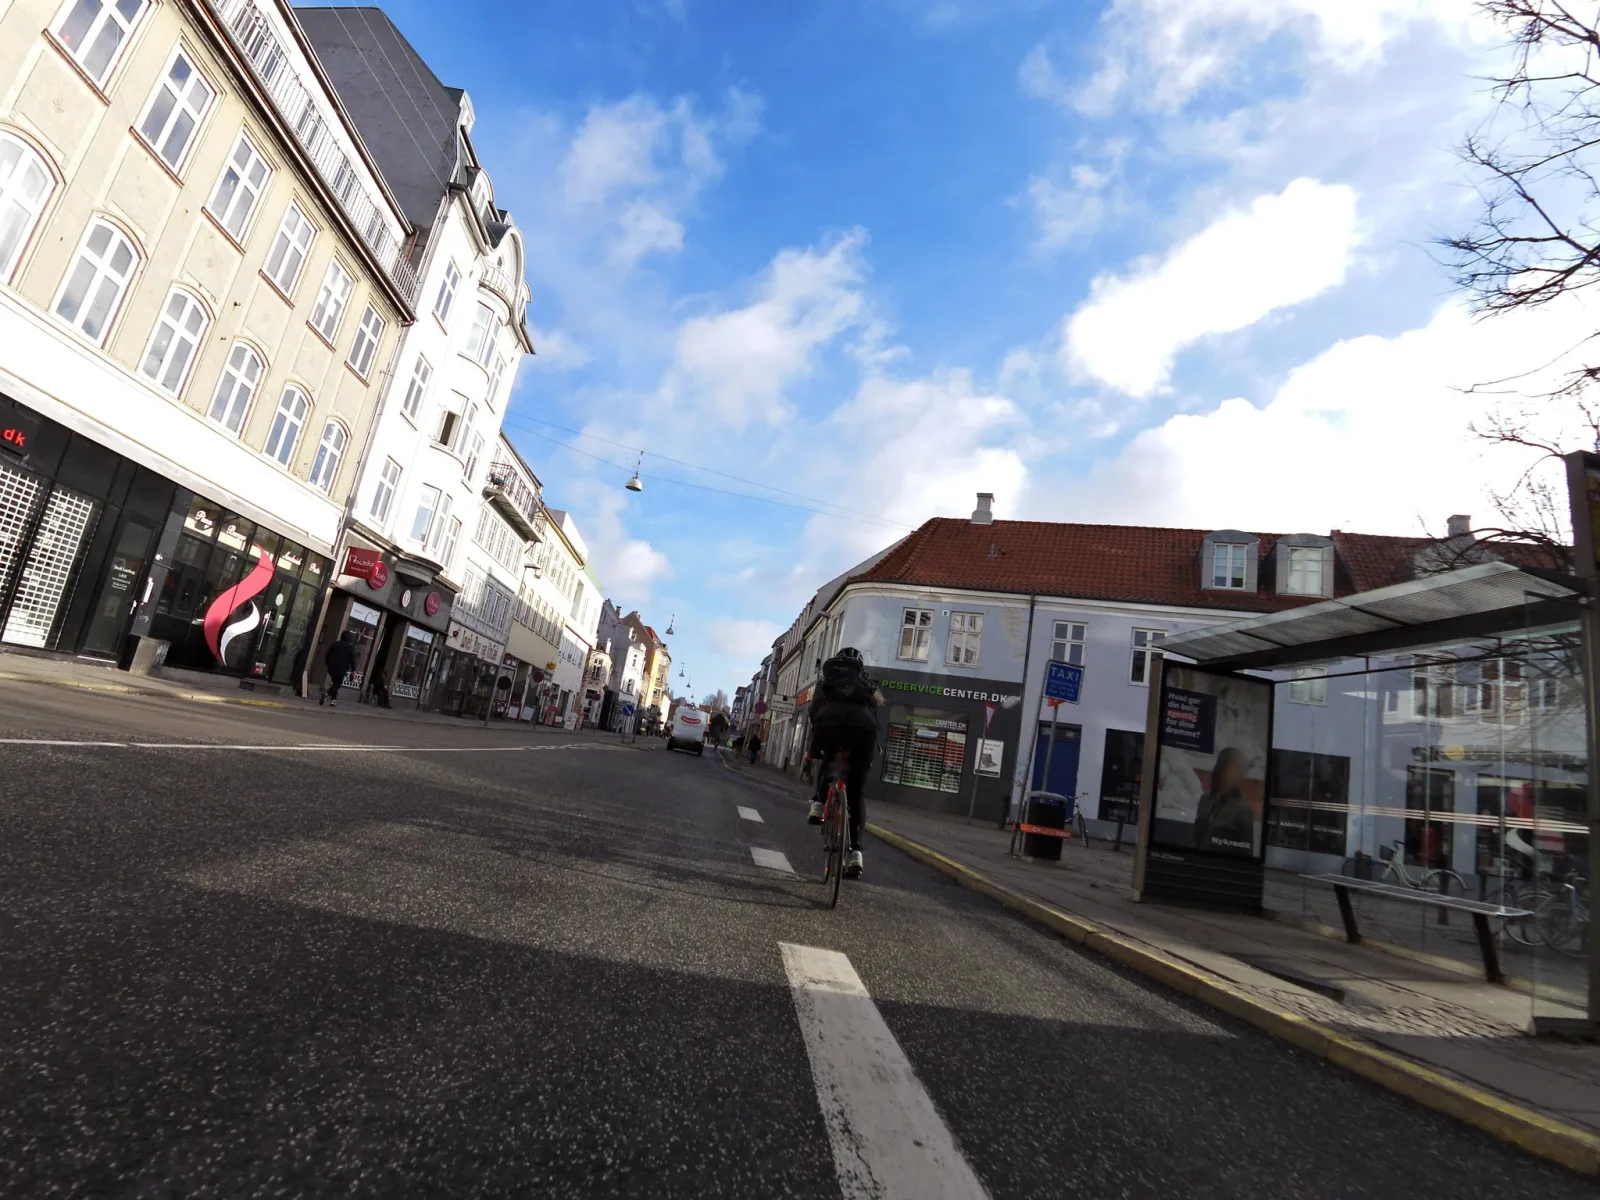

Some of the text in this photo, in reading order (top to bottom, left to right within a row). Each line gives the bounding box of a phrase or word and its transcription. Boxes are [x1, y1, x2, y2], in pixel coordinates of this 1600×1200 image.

[1051, 667, 1080, 682] TAXI
[881, 680, 1008, 704] PCSERVICECENTER.DK
[1168, 692, 1188, 702] Hvad
[1167, 701, 1180, 709] din
[1166, 718, 1178, 726] for
[1211, 836, 1252, 850] Nykredit
